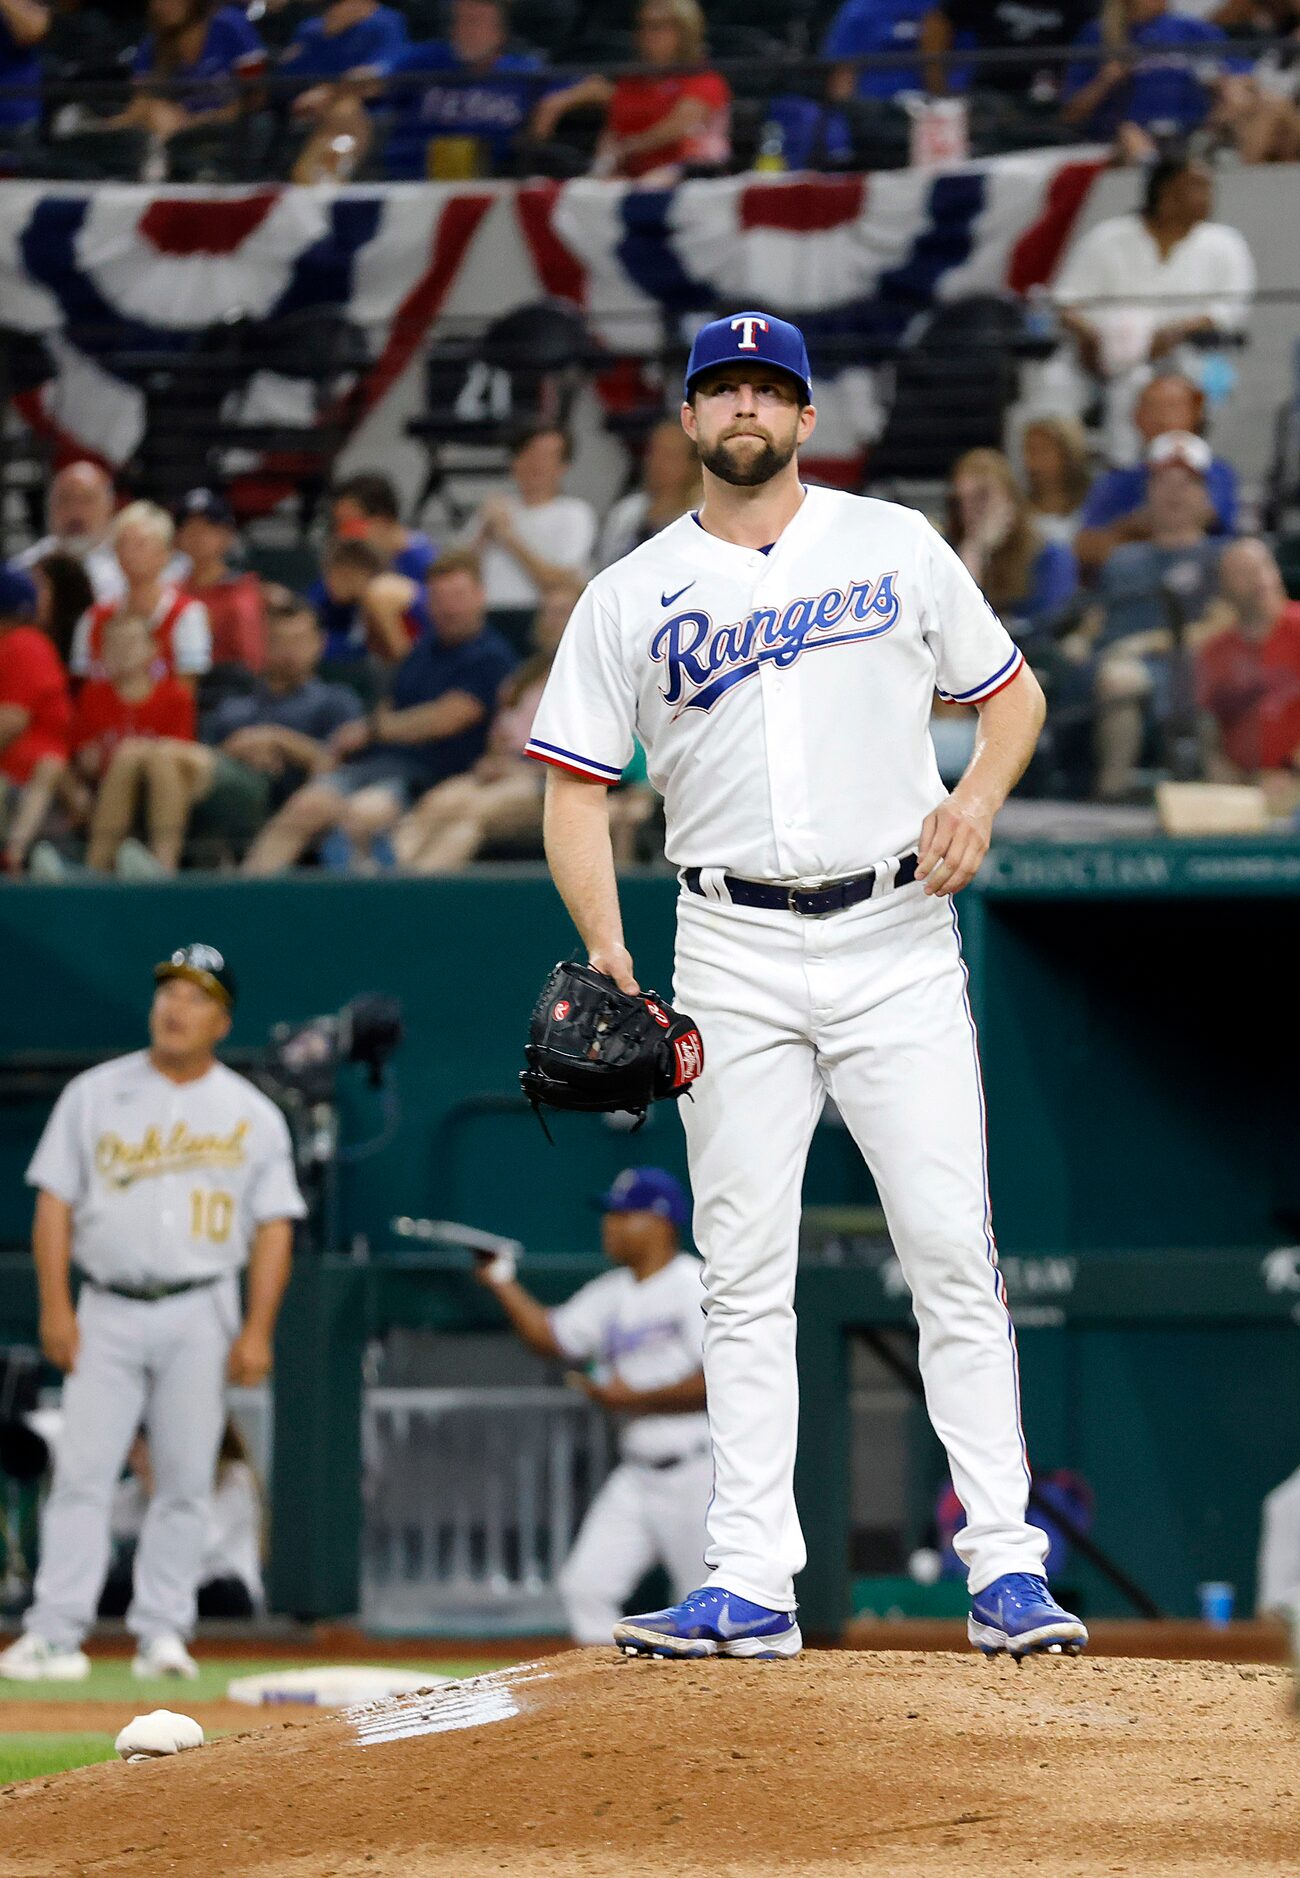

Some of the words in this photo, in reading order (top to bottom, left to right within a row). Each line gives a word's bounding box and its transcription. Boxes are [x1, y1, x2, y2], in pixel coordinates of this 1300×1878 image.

[731, 317, 769, 351] T
[647, 570, 902, 715] Rangers
[95, 1121, 250, 1188] Oakland
[190, 1189, 235, 1244] 10
